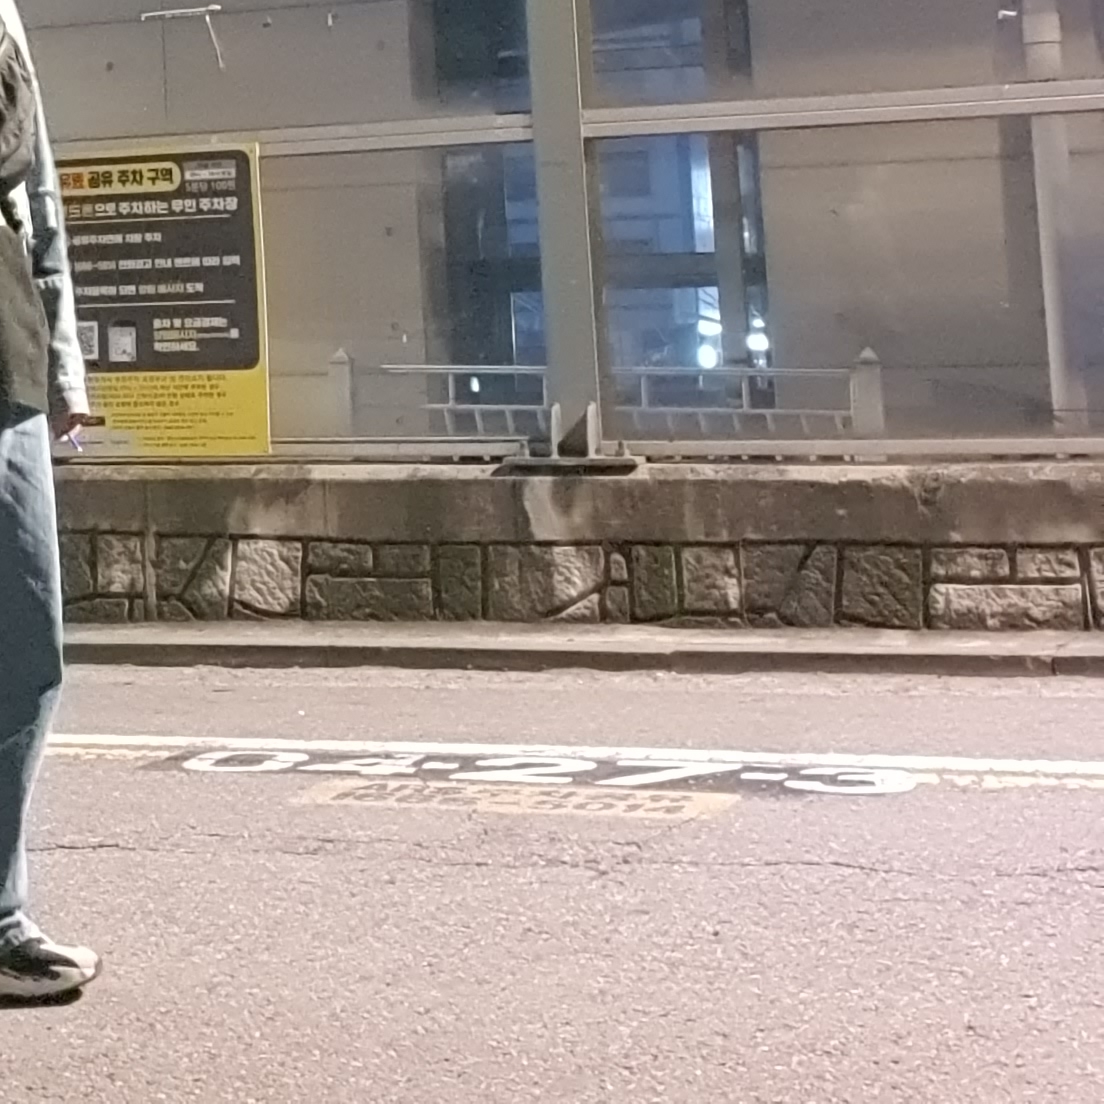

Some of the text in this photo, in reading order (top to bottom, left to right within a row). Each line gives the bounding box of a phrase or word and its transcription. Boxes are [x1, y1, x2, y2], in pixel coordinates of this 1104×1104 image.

[88, 171, 114, 189] 공유
[117, 168, 144, 188] 주차
[147, 167, 174, 186] 구역
[64, 196, 238, 218] 드폰으로 주차하는 무인 주차장
